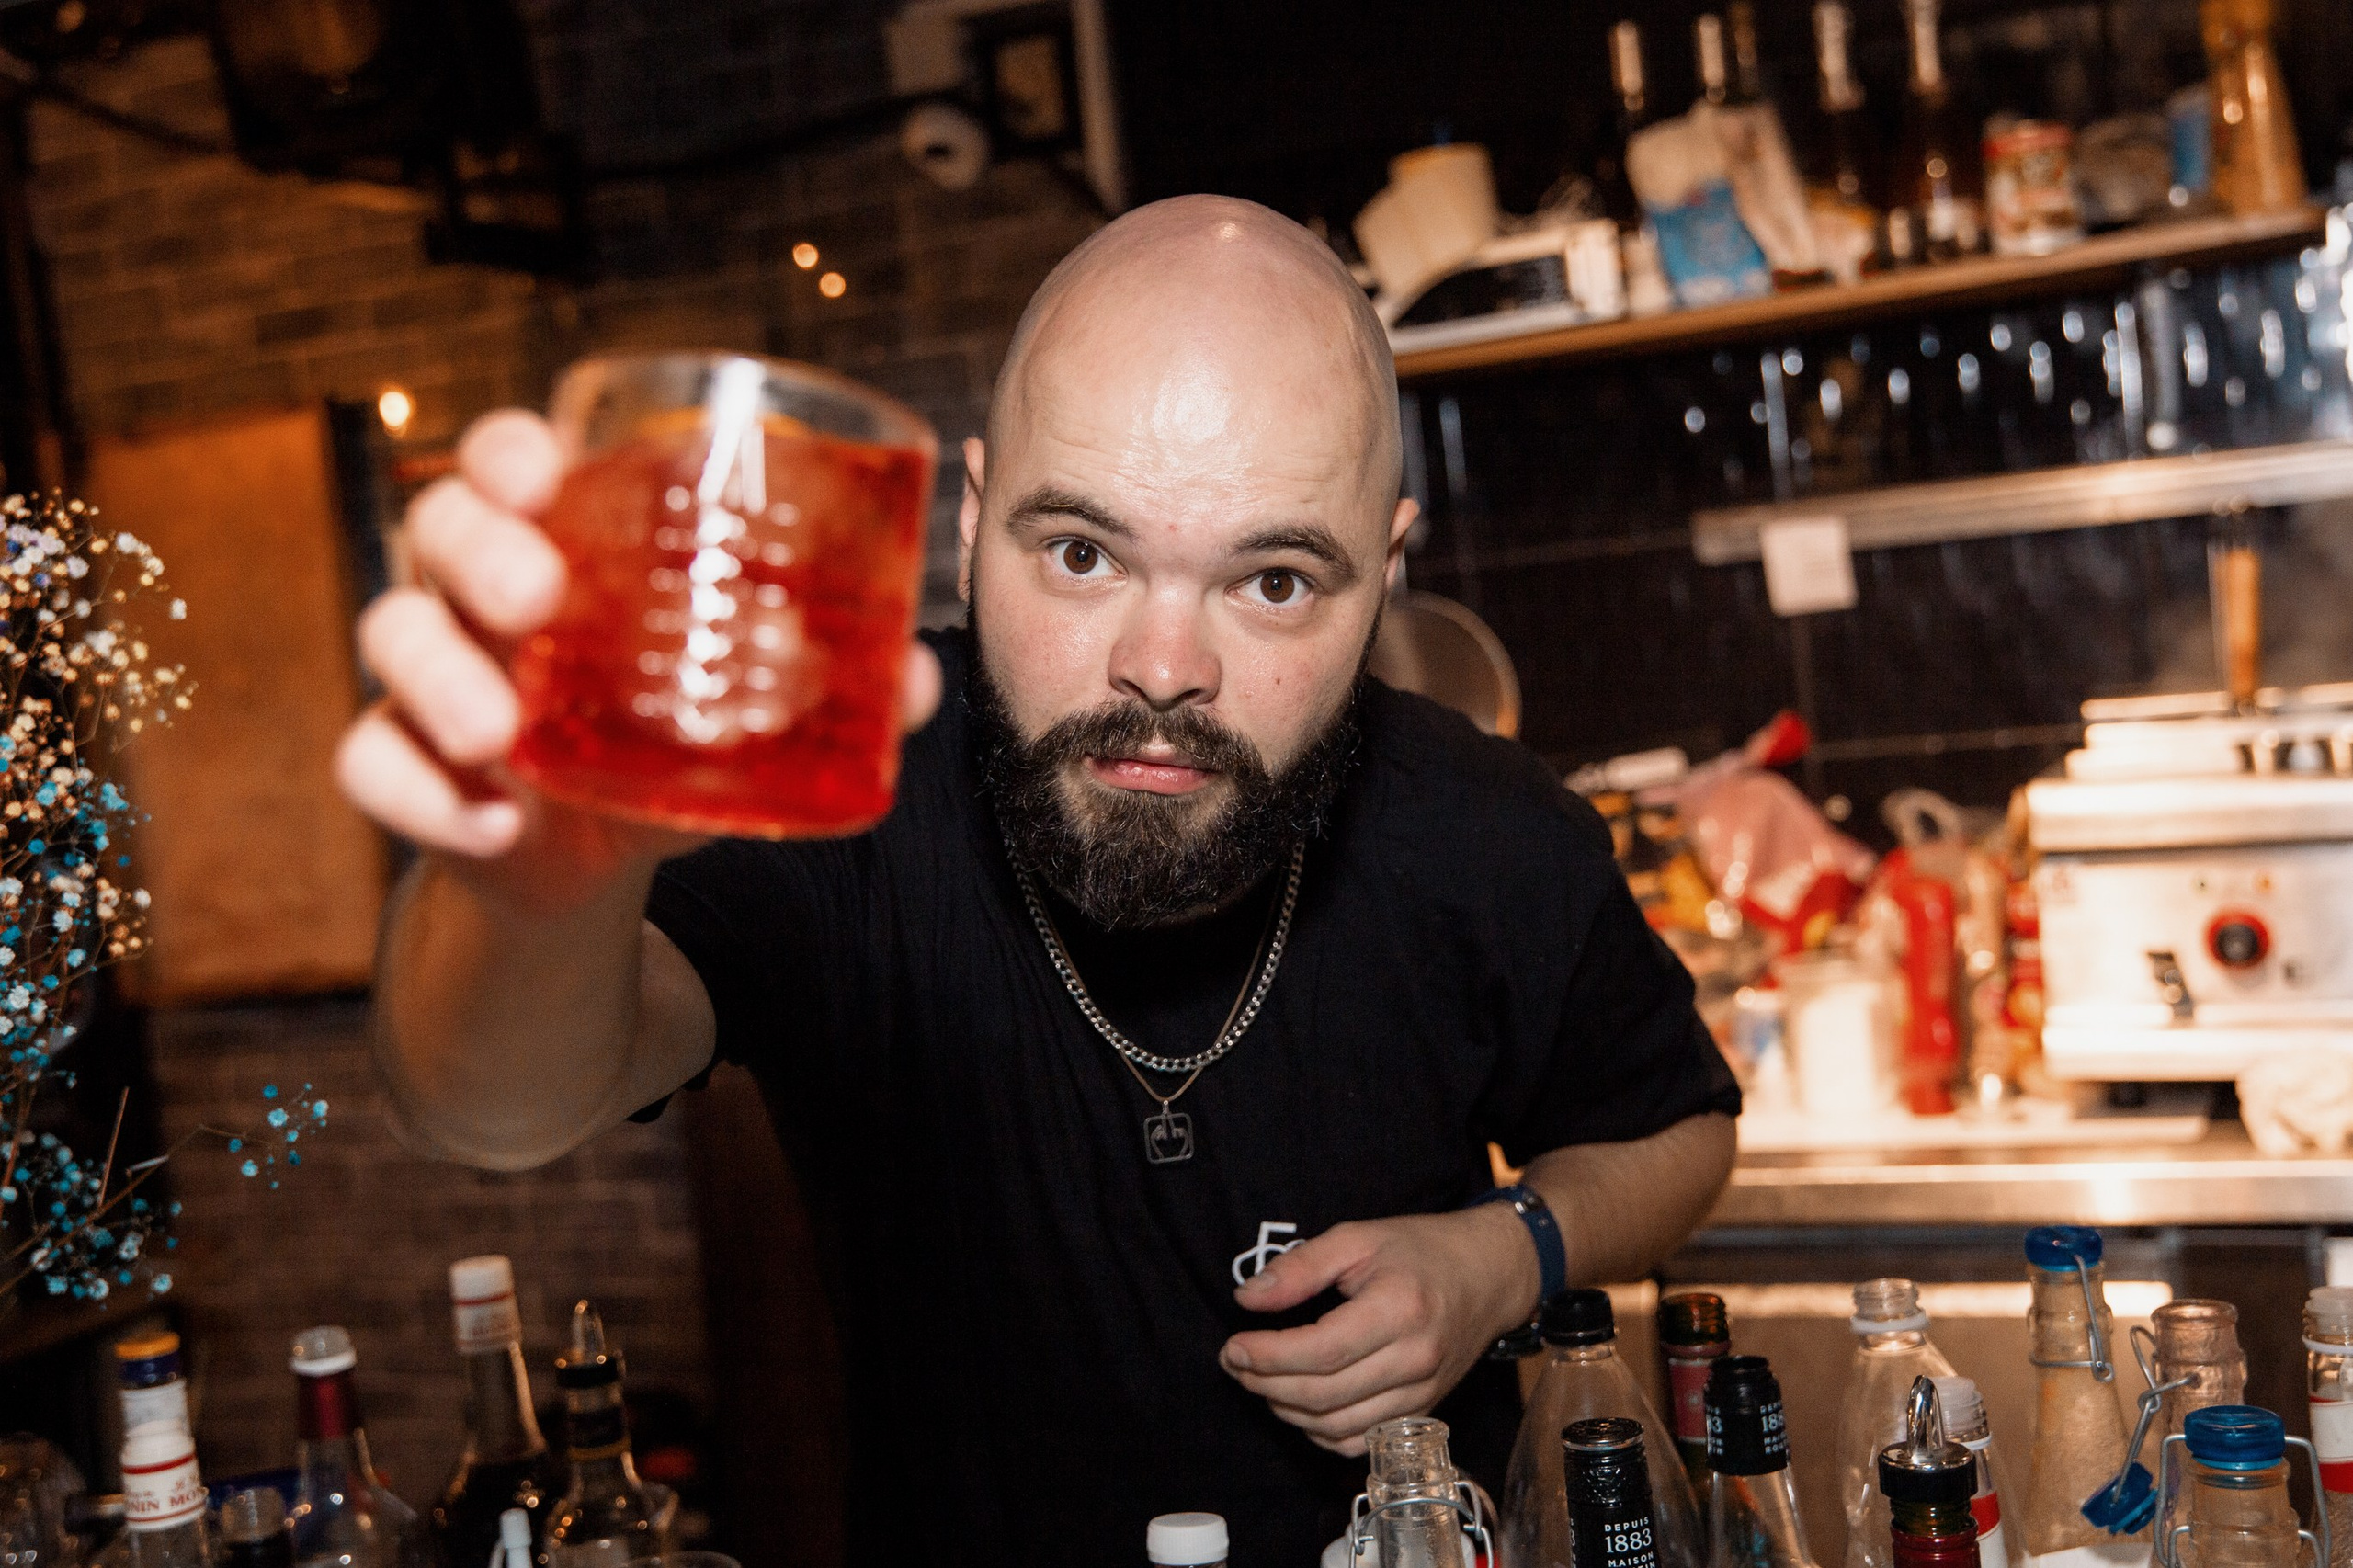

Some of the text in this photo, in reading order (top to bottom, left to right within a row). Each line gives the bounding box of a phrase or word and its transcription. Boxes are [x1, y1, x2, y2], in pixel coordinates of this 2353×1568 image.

[1604, 1517, 1649, 1532] DEPUIS
[1605, 1528, 1653, 1553] 1883
[1608, 1551, 1654, 1568] MAISON
